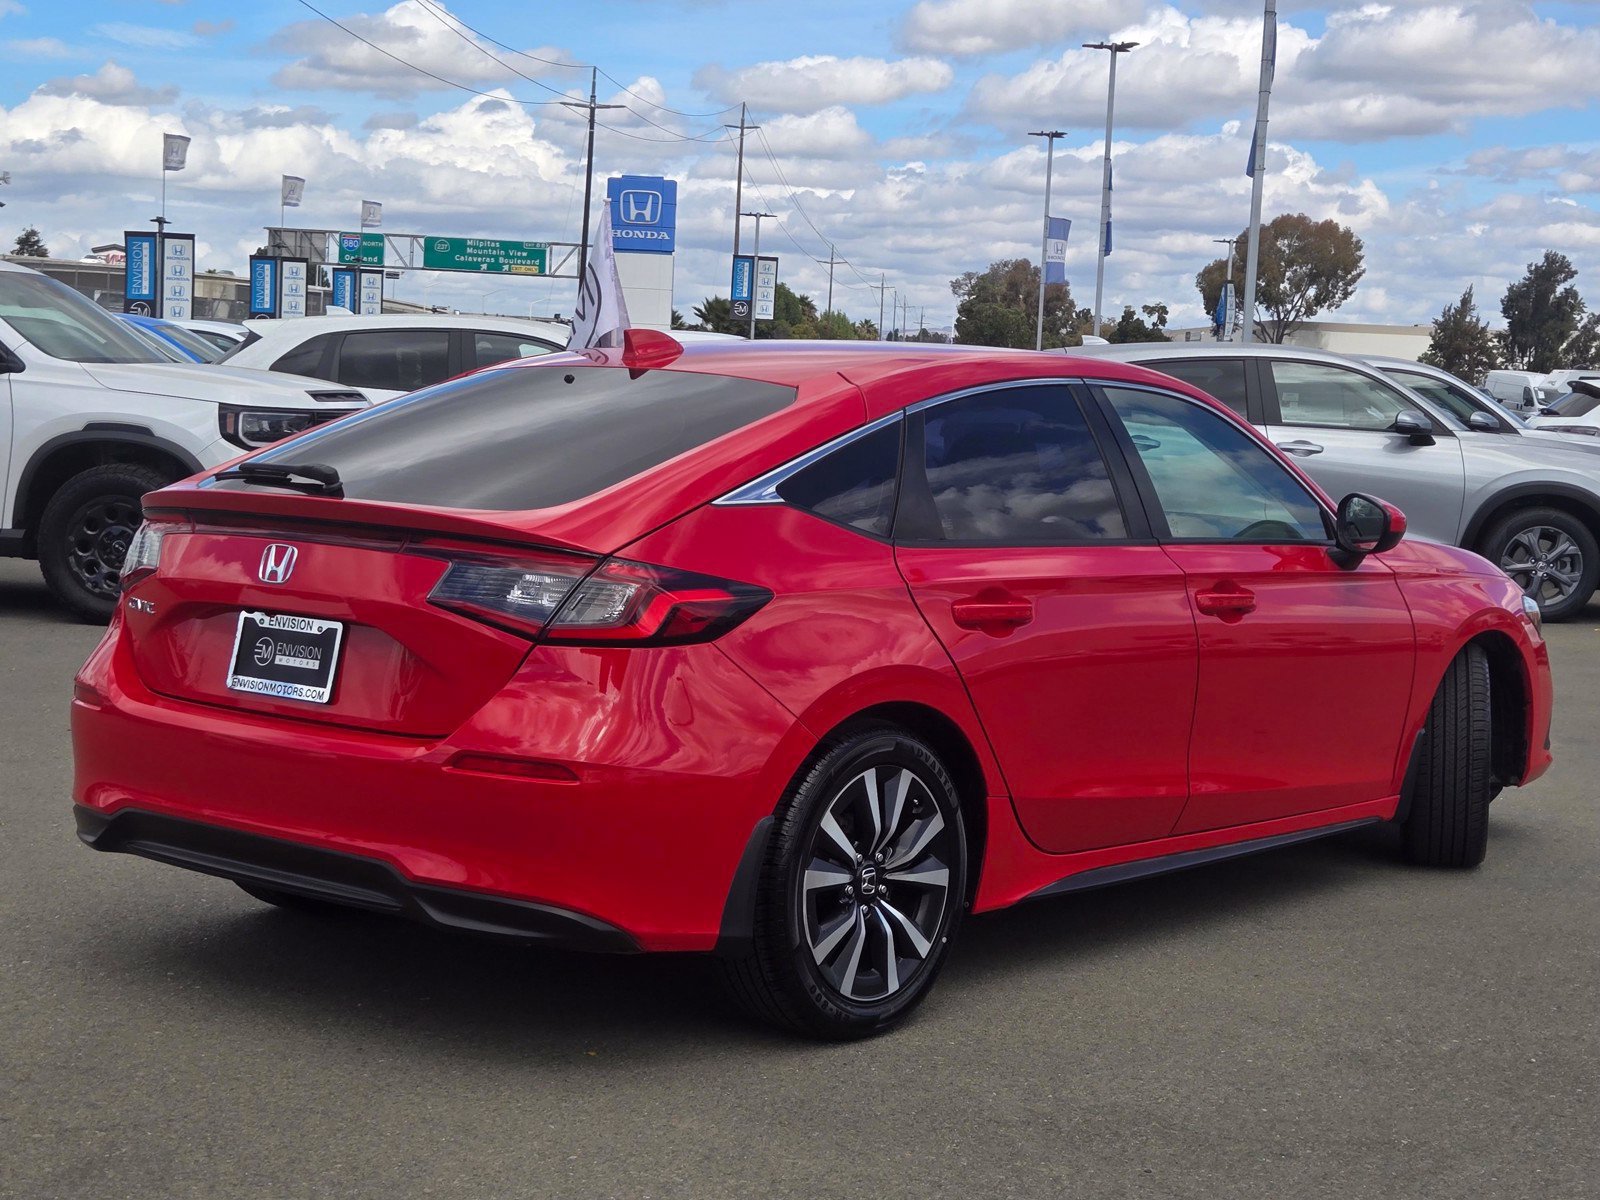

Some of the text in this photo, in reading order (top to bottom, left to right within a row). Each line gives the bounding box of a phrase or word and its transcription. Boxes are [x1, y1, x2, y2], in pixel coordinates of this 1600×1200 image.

[612, 230, 670, 240] HONDA
[343, 239, 359, 248] 880
[466, 240, 500, 248] Milpitas
[466, 248, 505, 256] Mountain
[454, 255, 540, 265] Calaveras Boulevard
[132, 241, 142, 295] ENVISION
[256, 263, 265, 309] ENVISION
[736, 261, 744, 297] ENVISION
[337, 274, 345, 307] NVISION
[268, 617, 314, 631] ENVISION
[276, 642, 322, 660] ENVISION
[278, 658, 316, 668] MOTORS
[231, 677, 325, 700] ENVISIONMOTORS.COM
